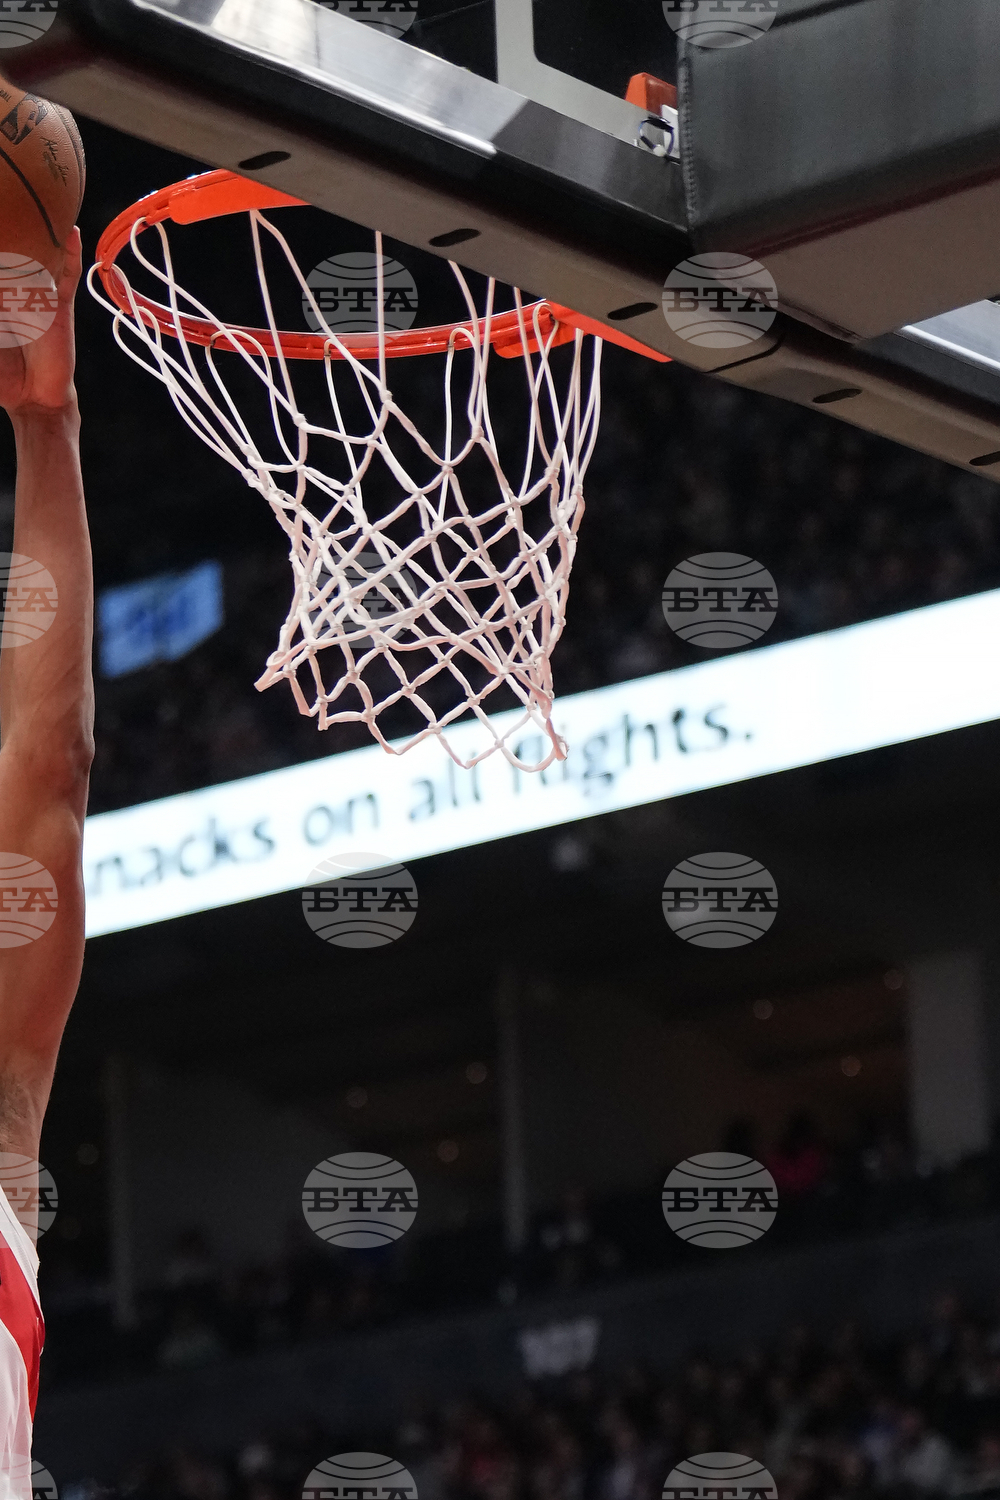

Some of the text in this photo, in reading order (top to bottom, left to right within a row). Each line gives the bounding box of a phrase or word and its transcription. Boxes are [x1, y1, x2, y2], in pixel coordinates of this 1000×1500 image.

[86, 815, 276, 897] nacks
[303, 793, 380, 846] on
[408, 750, 482, 822] all
